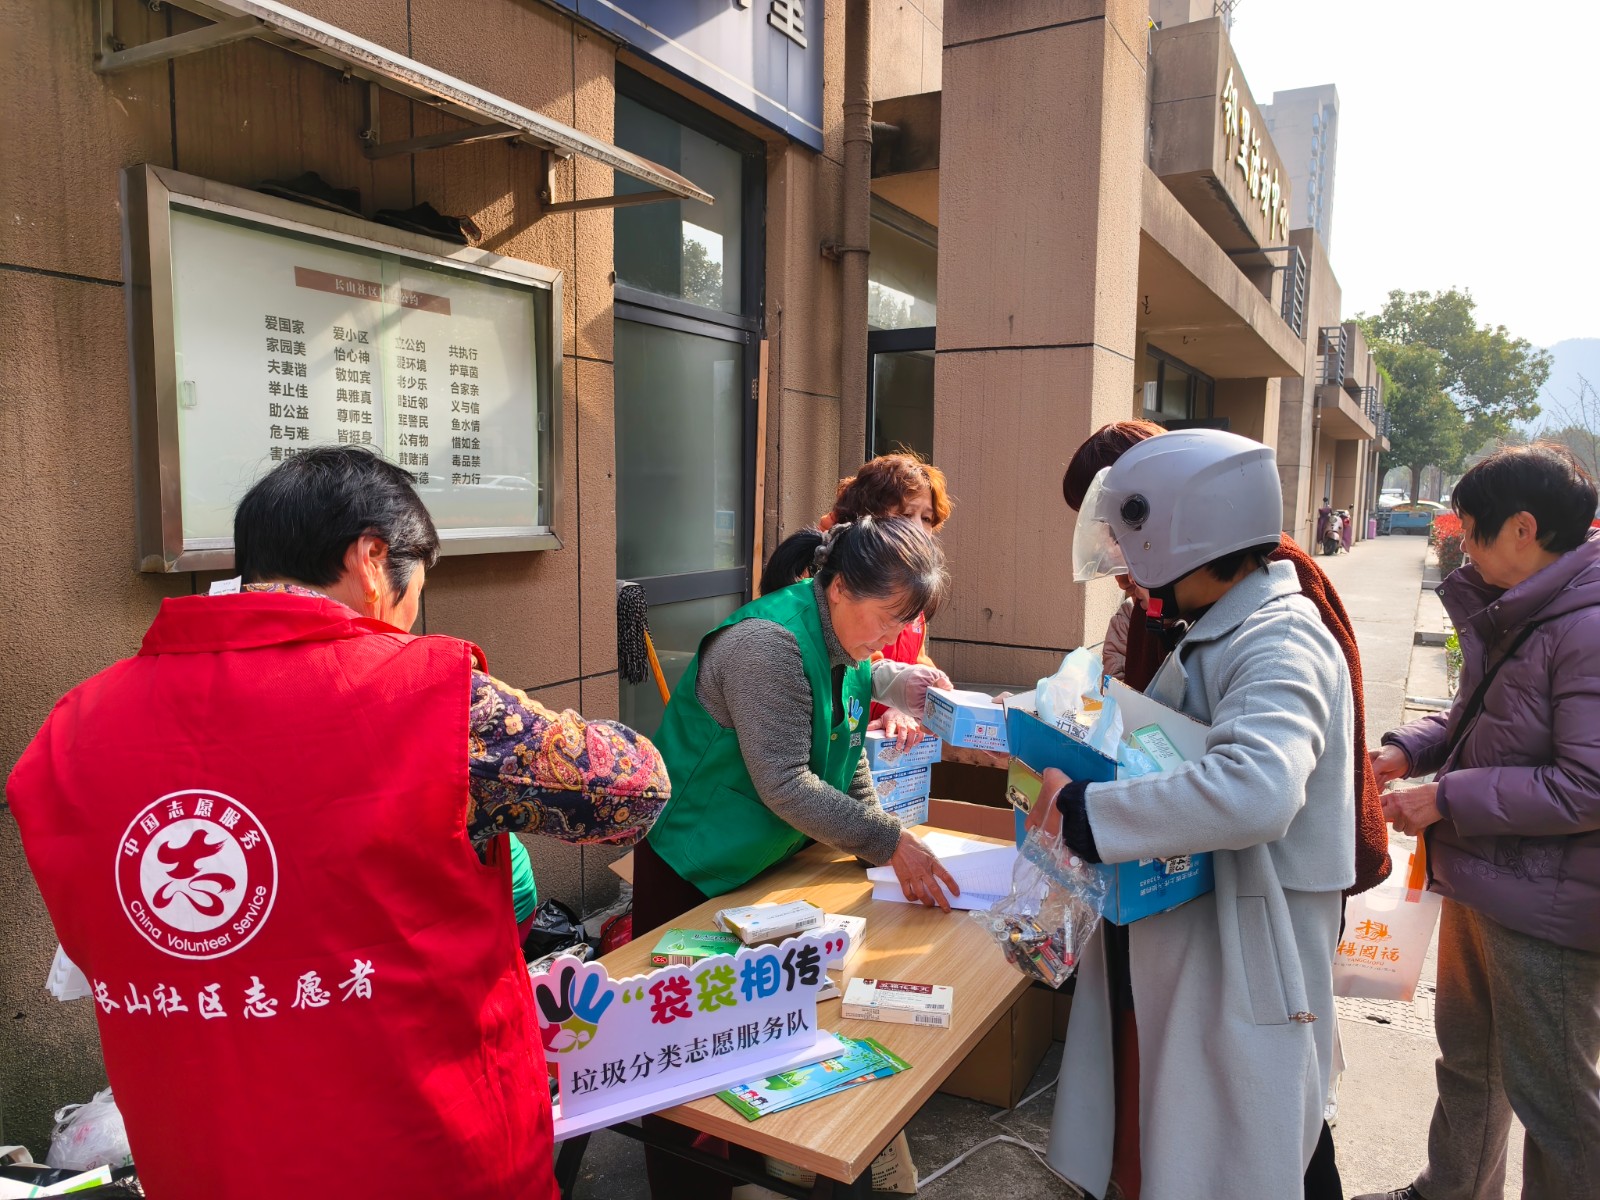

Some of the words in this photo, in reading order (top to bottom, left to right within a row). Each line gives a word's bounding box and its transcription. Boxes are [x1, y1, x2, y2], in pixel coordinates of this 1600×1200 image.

[335, 278, 419, 306] 长山社区公约
[264, 314, 305, 335] 爱国家
[333, 326, 369, 345] 爱小区
[395, 336, 426, 353] 立公约
[449, 344, 478, 360] 共执行
[266, 337, 306, 357] 家园美
[334, 347, 370, 365] 怡心神
[267, 359, 307, 378] 夫妻谐
[335, 367, 371, 385] 敬如宾
[397, 375, 427, 391] 老少乐
[450, 381, 479, 397] 合家亲
[268, 380, 308, 399] 举止佳
[336, 388, 371, 405] 典雅真
[451, 400, 480, 415] 义与信
[269, 402, 309, 420] 助公益
[337, 408, 372, 425] 尊师生
[398, 413, 429, 429] 军警民
[451, 418, 480, 433] 鱼水情
[270, 424, 310, 441] 危与难
[337, 428, 373, 445] 皆挺身
[398, 433, 429, 448] 公有物
[452, 436, 480, 450] 惜如金
[451, 472, 481, 485] 亲力行
[452, 454, 481, 468] 毒品禁
[123, 797, 262, 858] 中国志愿服务
[130, 900, 162, 940] China
[167, 931, 232, 953] Volunteer
[233, 885, 267, 935] Service
[92, 958, 376, 1019] 长山社区志愿者
[571, 1008, 810, 1096] 垃圾分类志愿服务队
